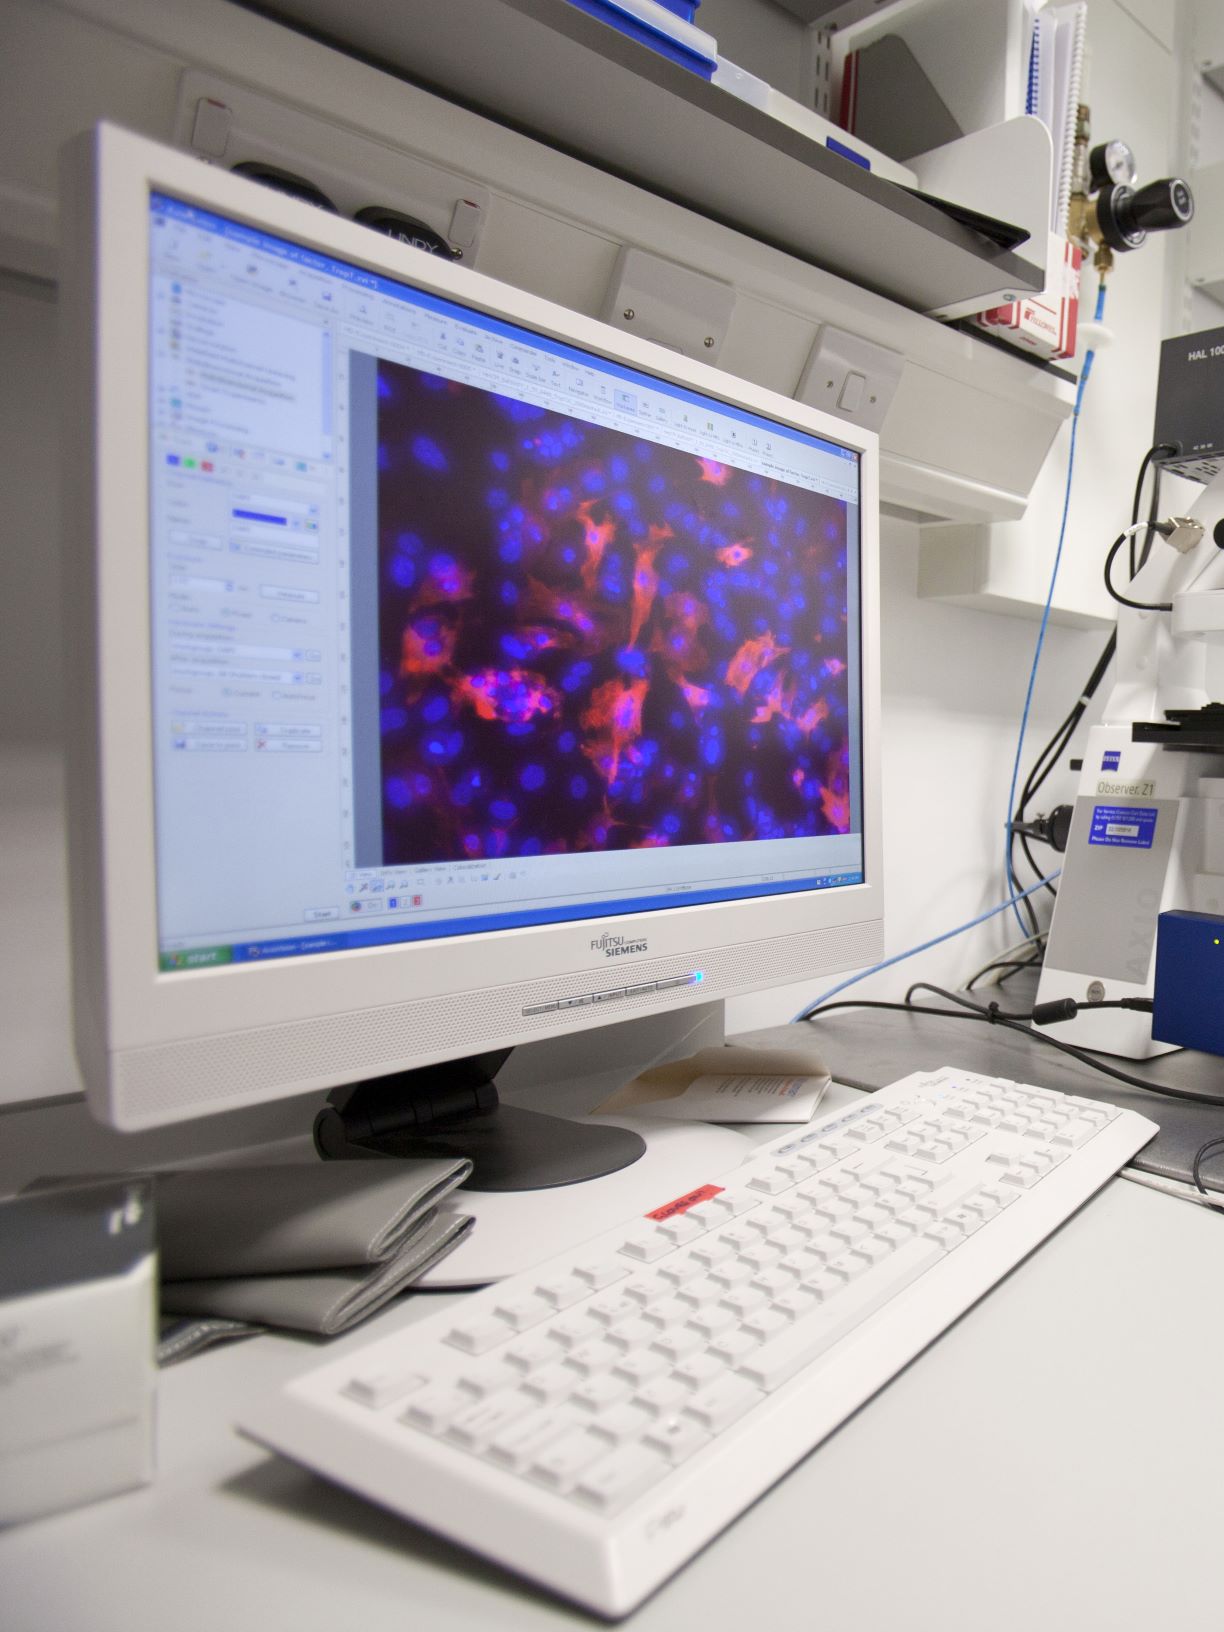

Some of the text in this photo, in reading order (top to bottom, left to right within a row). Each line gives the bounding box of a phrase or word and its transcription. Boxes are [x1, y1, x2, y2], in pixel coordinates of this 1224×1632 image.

[1188, 349, 1208, 361] HAL
[590, 932, 624, 951] FUJITSU
[605, 942, 648, 957] SIEMENS
[187, 951, 217, 964] start
